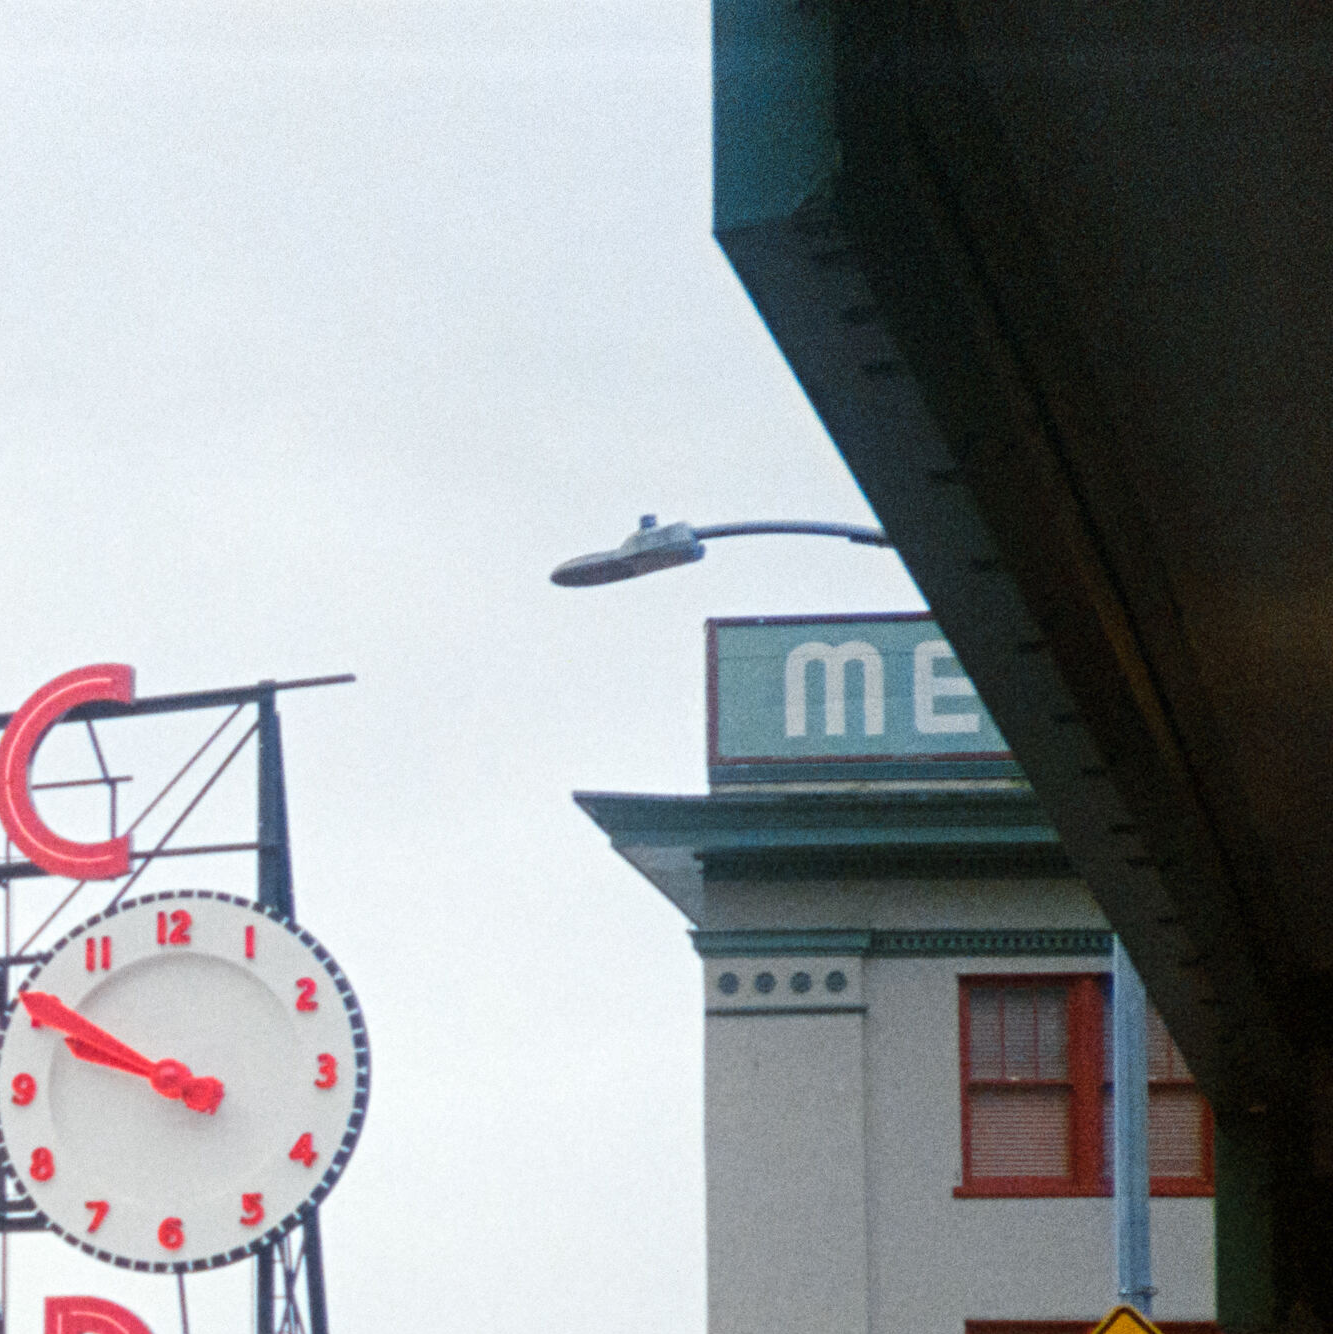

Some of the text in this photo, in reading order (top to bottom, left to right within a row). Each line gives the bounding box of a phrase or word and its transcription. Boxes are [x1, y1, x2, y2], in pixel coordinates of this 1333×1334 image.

[157, 909, 192, 946] 12
[245, 925, 256, 959] 1
[85, 936, 112, 972] 11
[295, 977, 319, 1013] 2
[314, 1053, 339, 1090] 3
[11, 1073, 37, 1106] 9
[29, 1147, 56, 1182] 8
[288, 1132, 319, 1167] 4
[85, 1200, 110, 1233] 7
[240, 1193, 266, 1226] 5
[158, 1217, 185, 1251] 6
